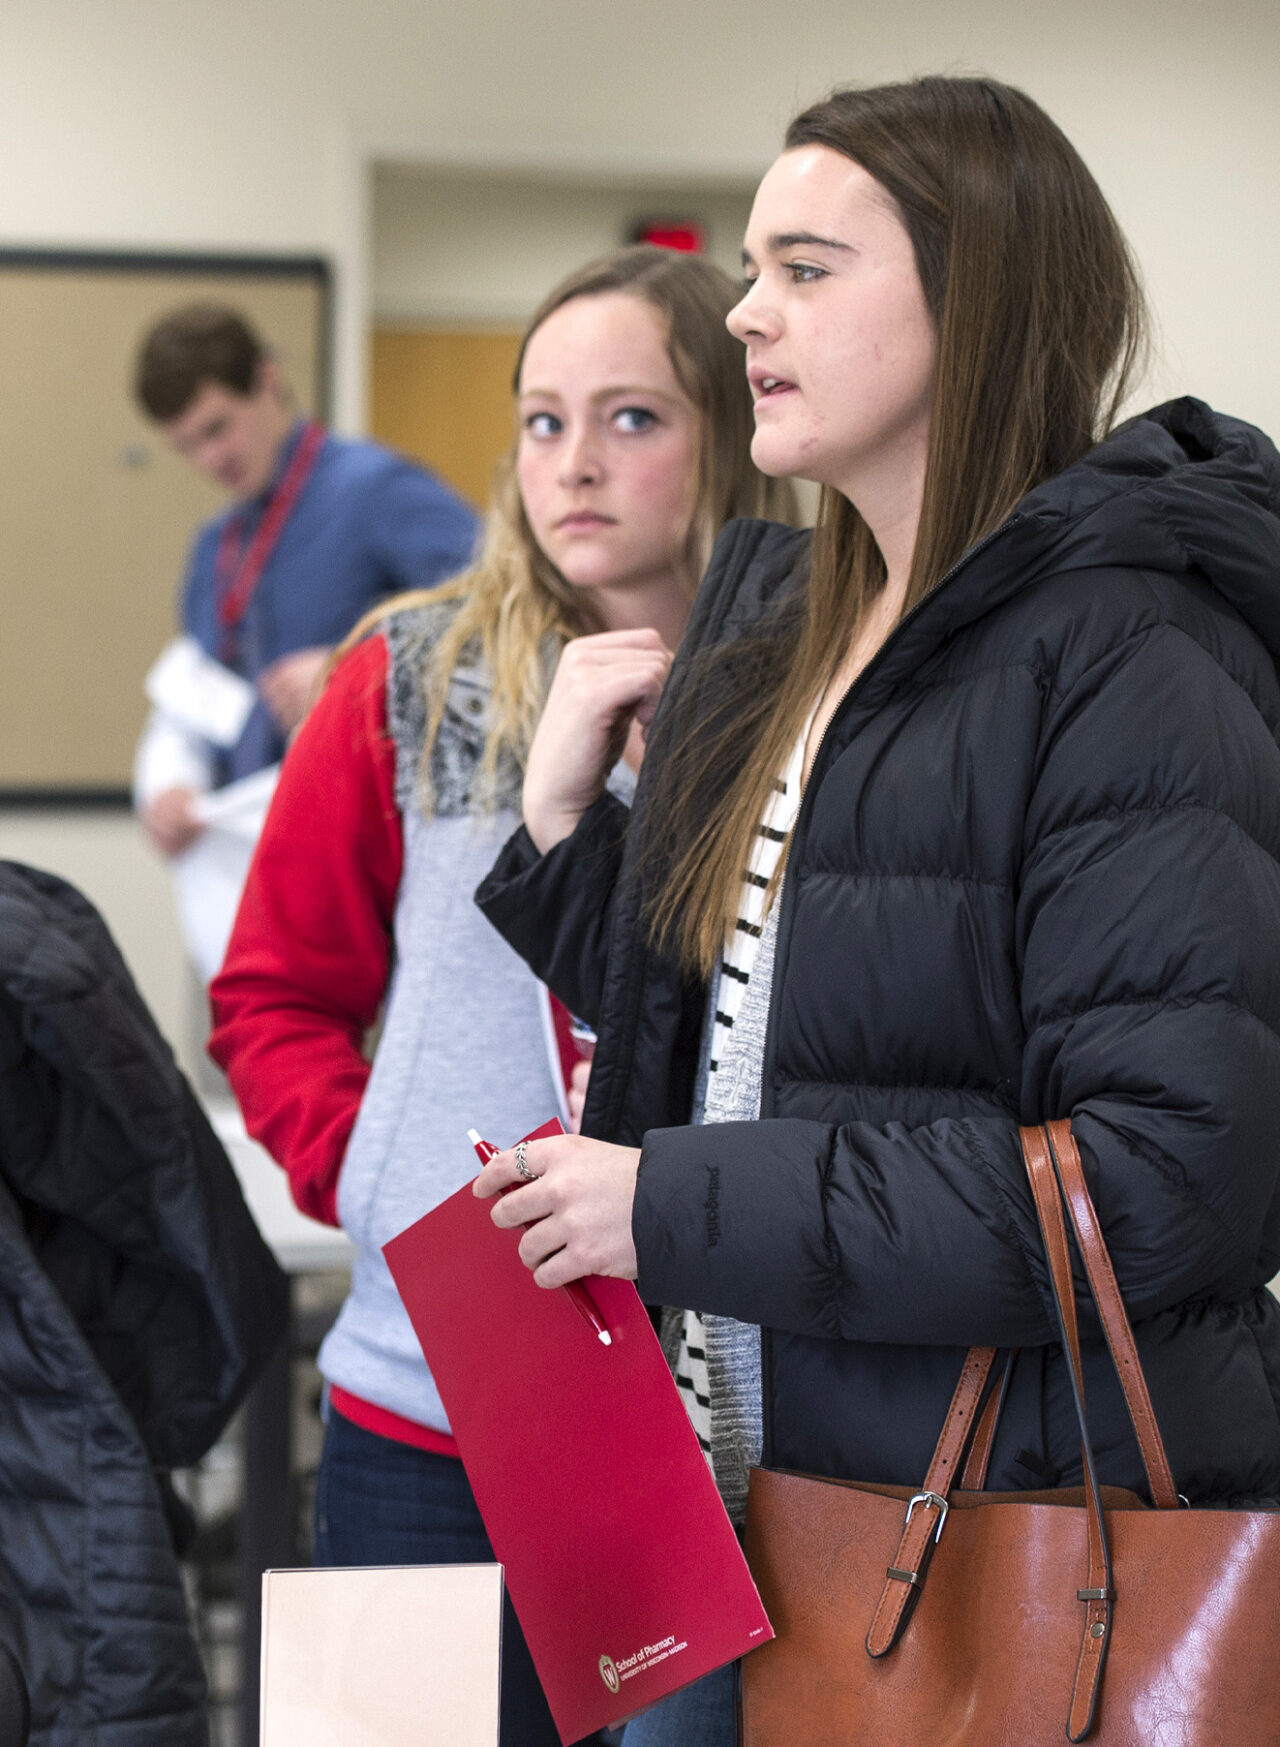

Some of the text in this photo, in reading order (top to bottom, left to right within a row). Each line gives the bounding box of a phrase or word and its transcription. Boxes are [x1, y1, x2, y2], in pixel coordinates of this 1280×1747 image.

[703, 1165, 720, 1249] patagonia
[615, 1635, 676, 1673] School of Pharmacy
[603, 1666, 616, 1686] W
[620, 1665, 642, 1681] UNIVERSITY
